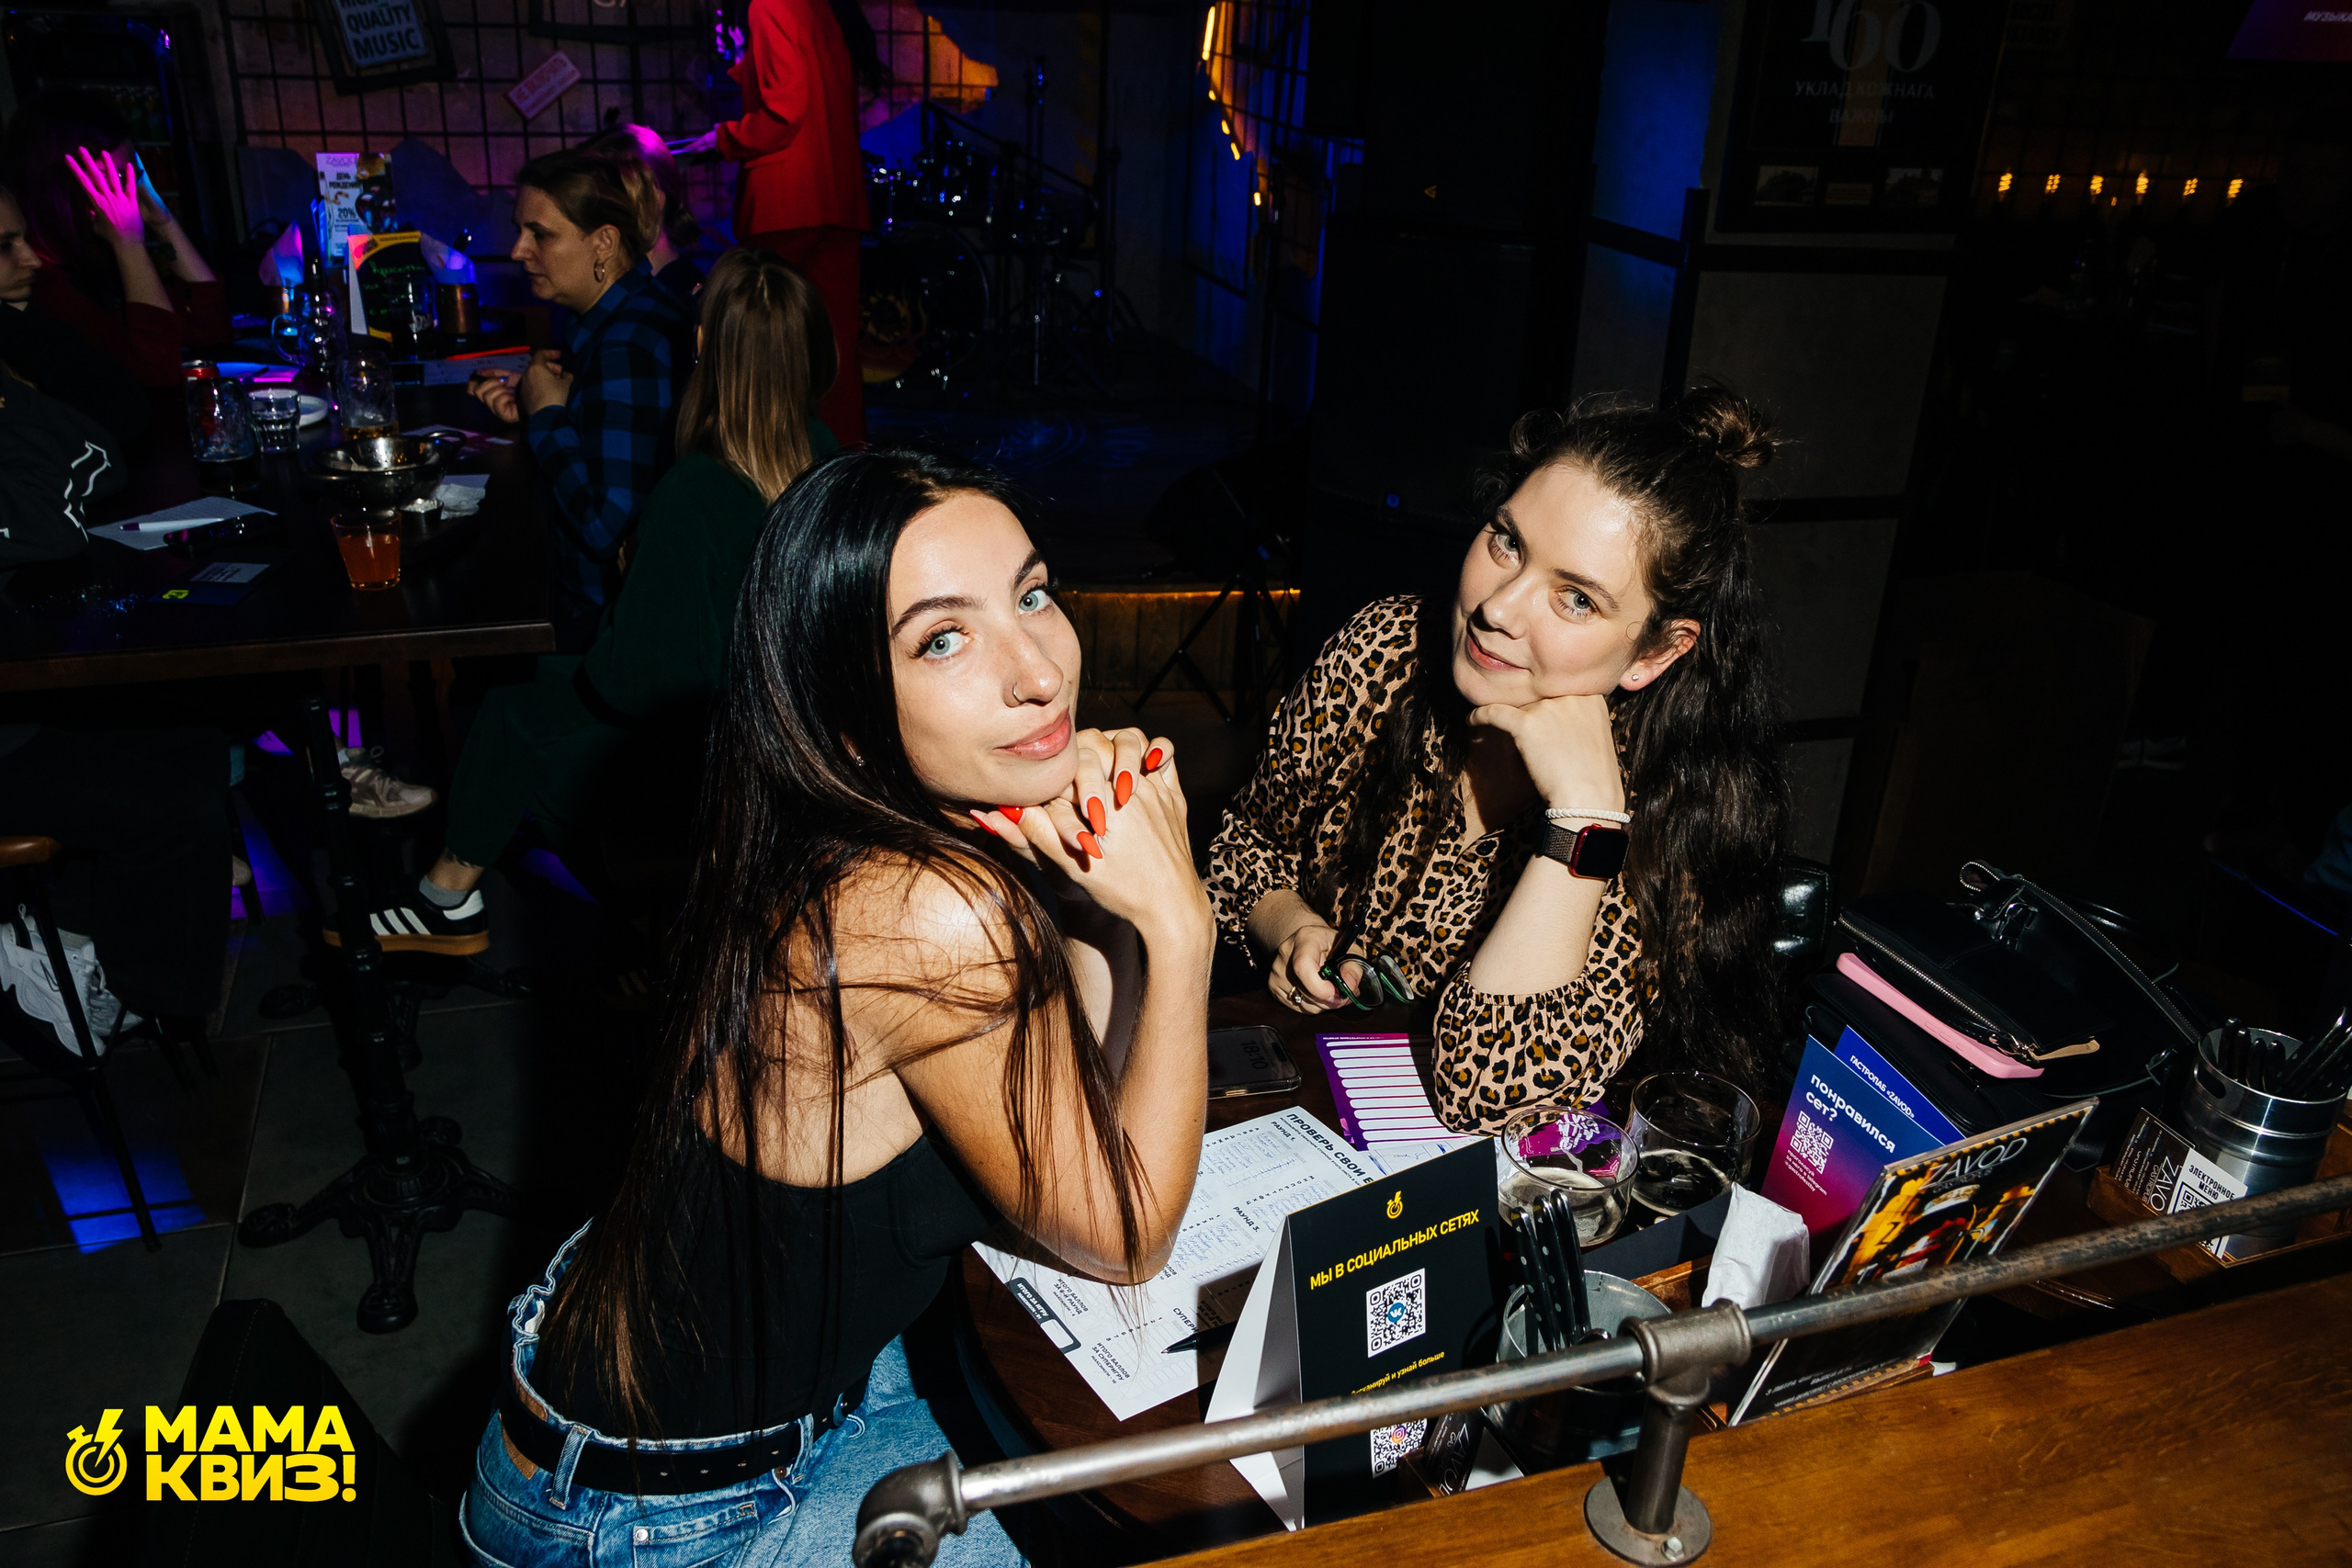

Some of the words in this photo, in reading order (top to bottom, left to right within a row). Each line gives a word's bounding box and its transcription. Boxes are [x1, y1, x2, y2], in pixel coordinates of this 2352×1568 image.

[345, 5, 411, 34] QUALITY
[353, 28, 420, 60] MUSIC
[1849, 1055, 1887, 1092] ГАСТРОПАБ
[1886, 1089, 1915, 1118] «ZAVOD»
[1805, 1091, 1838, 1122] сет?
[1810, 1074, 1896, 1154] понравился
[1271, 1121, 1292, 1138] РАУНД
[1286, 1113, 1334, 1151] ПРОВЕРЬ
[1334, 1152, 1366, 1177] СВОИ
[1917, 1137, 2028, 1190] ZAVOD
[2150, 1156, 2182, 1212] ZAVO
[2188, 1165, 2235, 1200] ЭЛЕКТРОННОЕ
[2198, 1181, 2219, 1200] МЕНЮ
[1233, 1206, 1255, 1227] РАУНД
[1310, 1268, 1332, 1291] МЫ
[1335, 1263, 1344, 1279] В
[1347, 1224, 1438, 1273] СОЦИАЛЬНЫХ
[1440, 1209, 1479, 1235] СЕТЯХ
[1017, 1282, 1033, 1299] ИТОГО
[1172, 1307, 1198, 1332] СУПЕРИ
[1097, 1342, 1113, 1359] ИТОГО
[1111, 1358, 1131, 1379] БАЛЛОВ
[1098, 1353, 1125, 1381] СУПЕРИГРУ
[1396, 1360, 1418, 1379] узнай
[1418, 1351, 1445, 1368] больше
